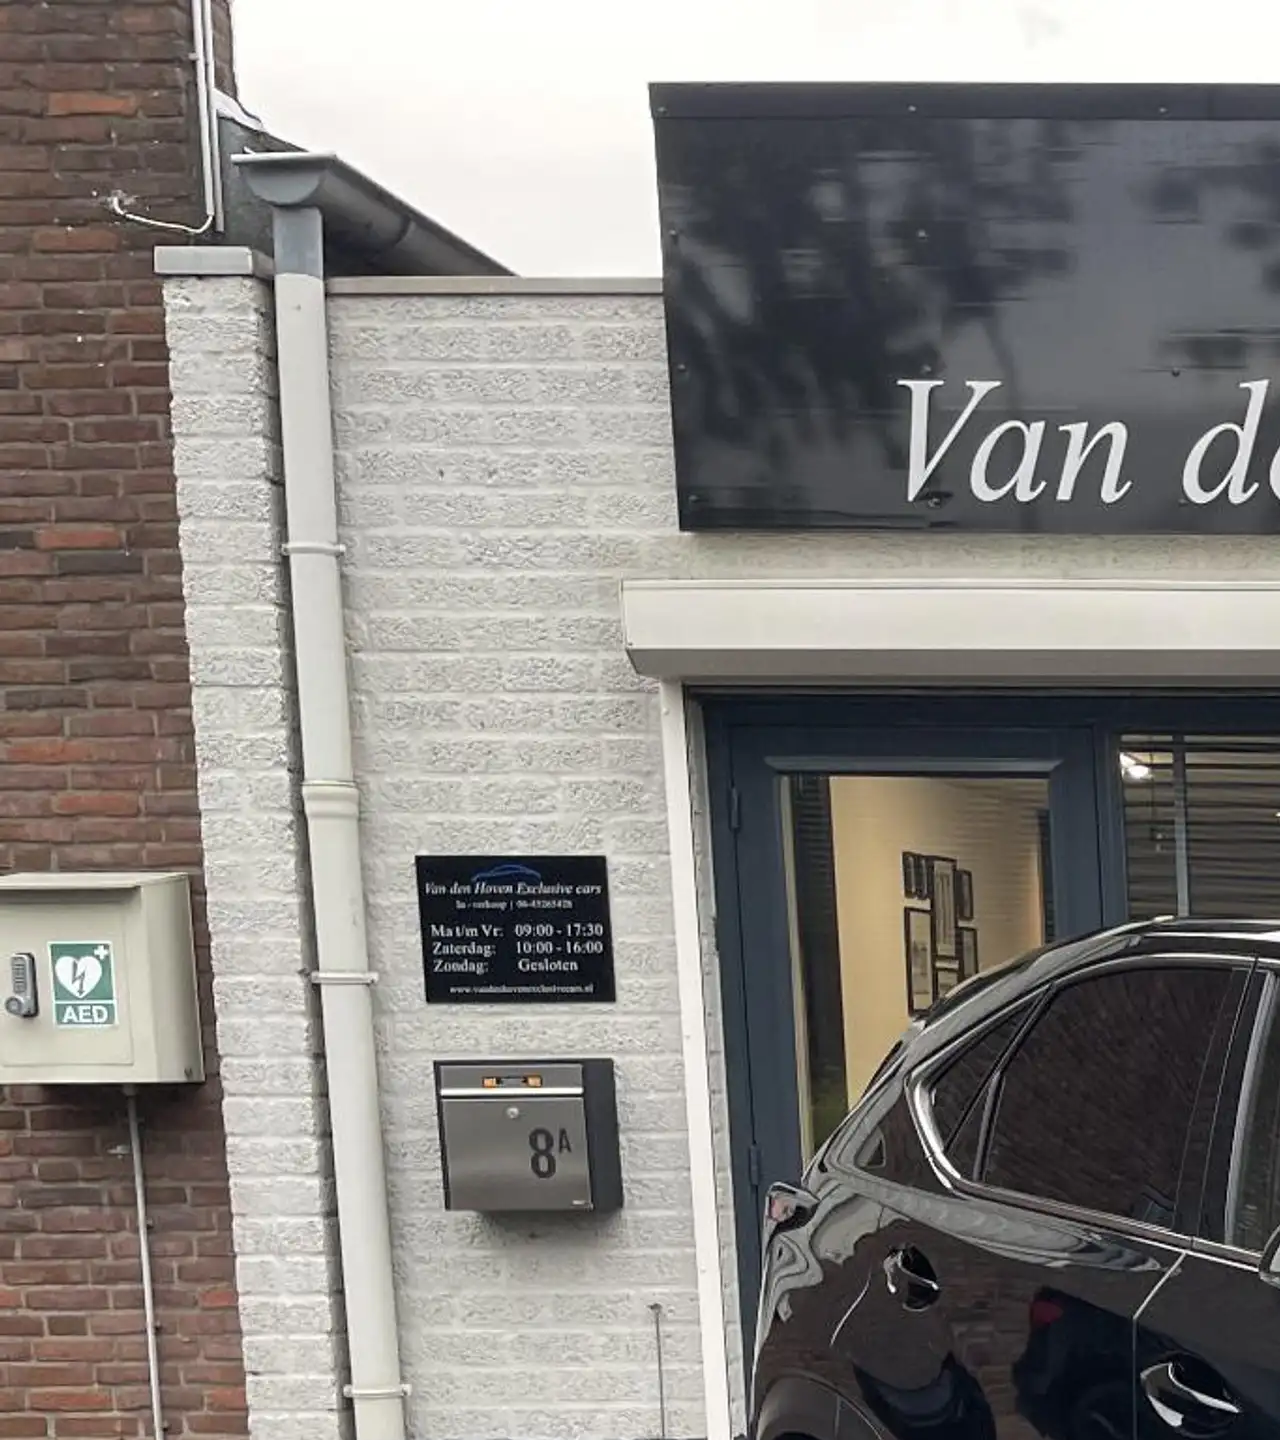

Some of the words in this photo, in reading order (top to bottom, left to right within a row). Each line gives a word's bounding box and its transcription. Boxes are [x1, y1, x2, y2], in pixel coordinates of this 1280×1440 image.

[897, 379, 1132, 504] Van
[425, 882, 446, 895] Van
[449, 881, 471, 895] den
[474, 881, 513, 895] Hoven
[516, 881, 573, 896] Exclusive
[575, 884, 602, 895] cars
[431, 924, 453, 937] Ma
[481, 924, 504, 937] Vr:
[515, 924, 554, 937] 09:00
[566, 923, 603, 937] 17:30
[432, 941, 497, 958] Zaterdag:
[516, 941, 553, 954] 10:00
[566, 941, 603, 954] 16:00
[433, 958, 489, 976] Zondag:
[518, 958, 578, 972] Gesloten
[62, 1005, 109, 1024] AED
